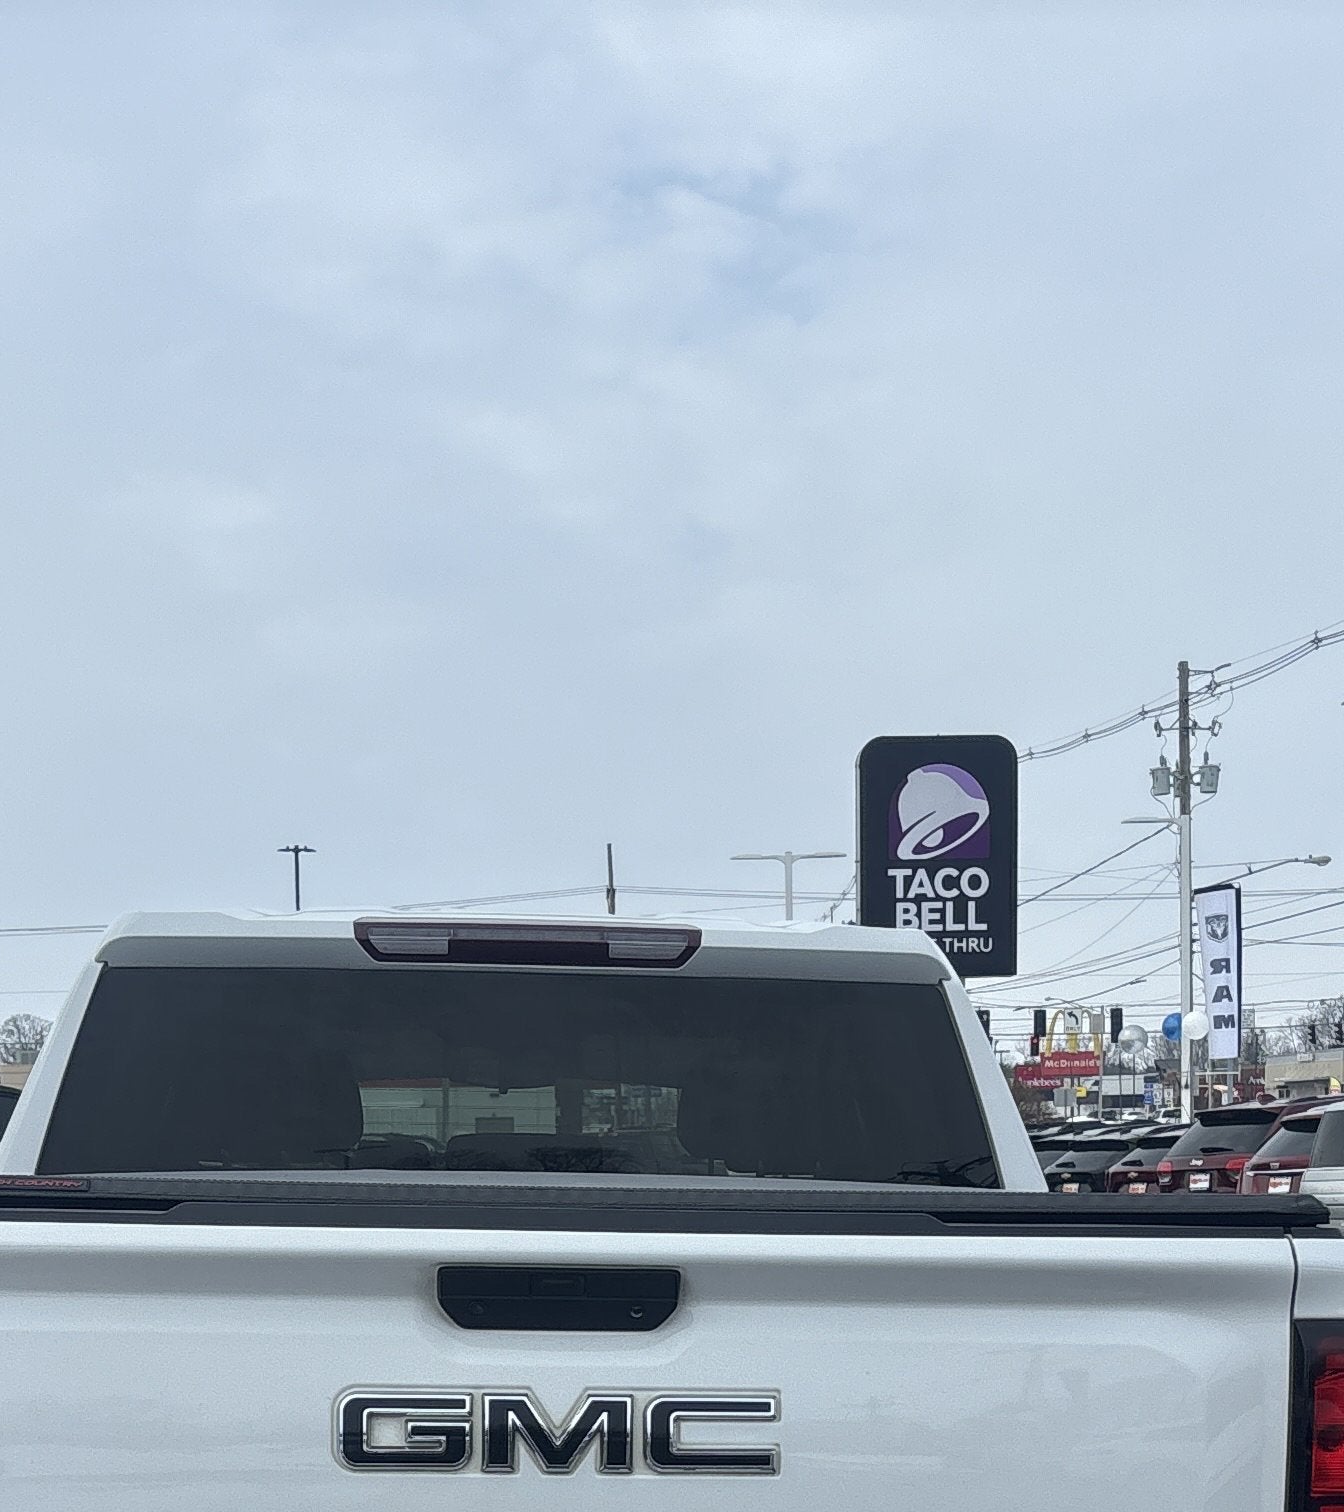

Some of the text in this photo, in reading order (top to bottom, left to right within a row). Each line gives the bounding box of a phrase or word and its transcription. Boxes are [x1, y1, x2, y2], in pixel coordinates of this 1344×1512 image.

[887, 867, 989, 898] TACO
[896, 901, 988, 931] BELL
[942, 937, 993, 953] THRU
[15, 1179, 83, 1187] COUNTRY
[338, 1391, 779, 1475] GMC
